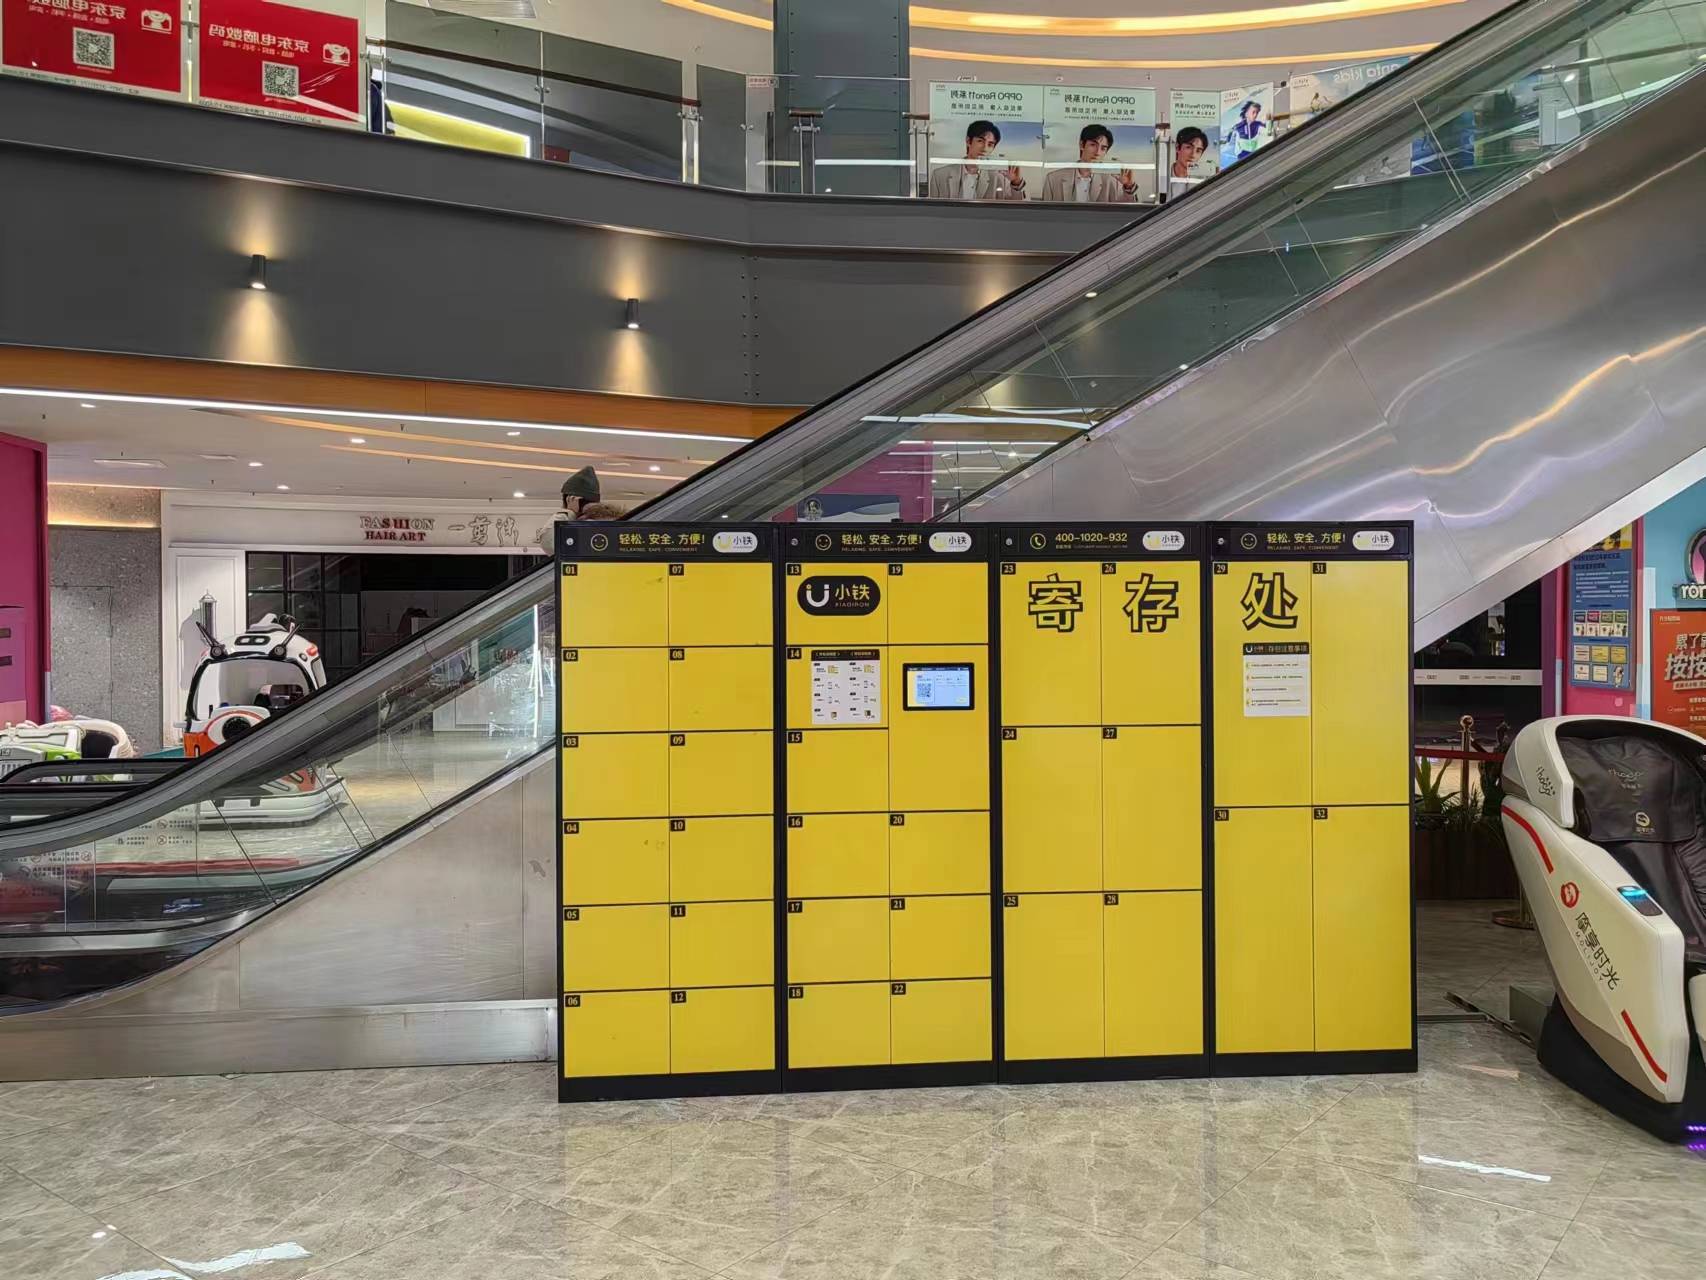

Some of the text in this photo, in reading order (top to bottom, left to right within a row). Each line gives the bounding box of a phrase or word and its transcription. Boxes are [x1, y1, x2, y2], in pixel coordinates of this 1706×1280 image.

[359, 516, 435, 531] FASHION
[366, 531, 426, 542] HAIR ART
[1055, 532, 1128, 542] 400-1020-932
[834, 583, 870, 601] 小铁
